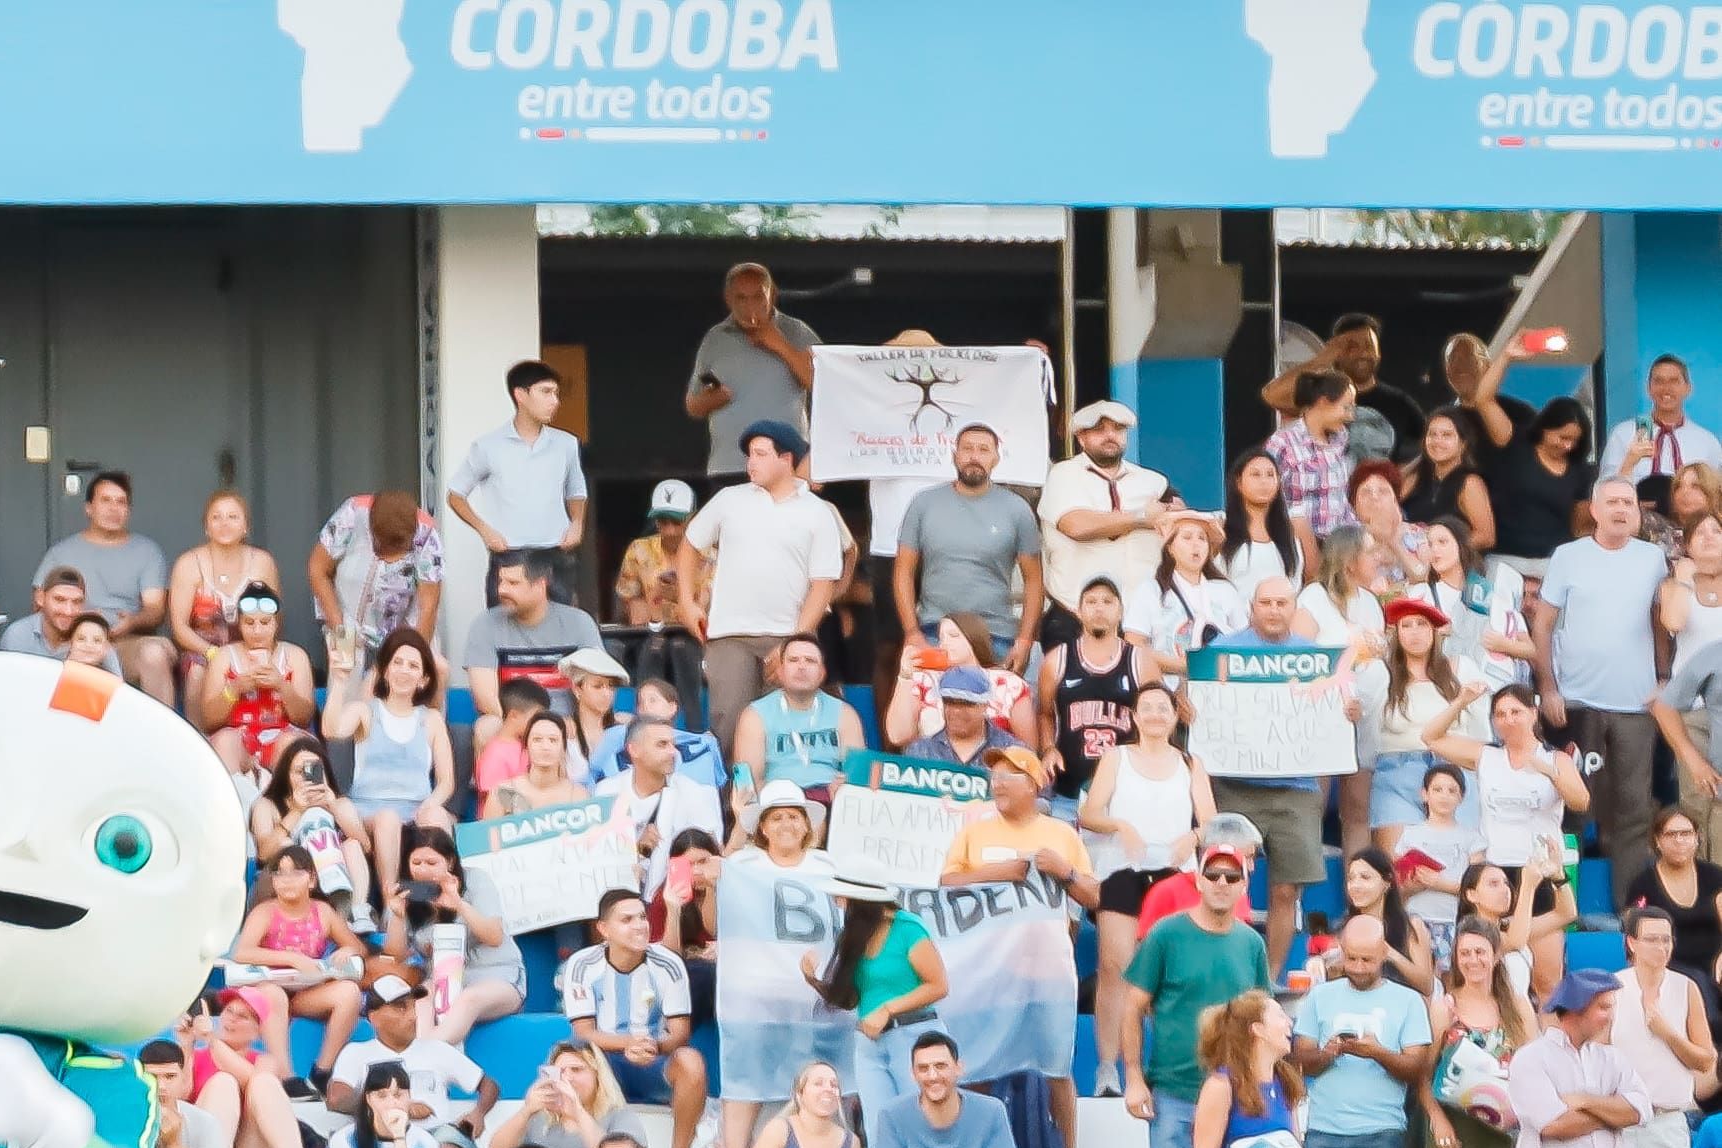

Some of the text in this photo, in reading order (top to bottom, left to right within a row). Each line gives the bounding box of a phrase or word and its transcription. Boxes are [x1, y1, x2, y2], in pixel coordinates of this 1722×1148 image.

[517, 73, 773, 120] entre todos
[1478, 82, 1722, 129] entre todos
[1228, 653, 1331, 679] BANCOR
[1069, 699, 1132, 732] BULLS
[1083, 728, 1117, 758] 23
[881, 762, 990, 800] BANCOR
[499, 803, 603, 843] BANCOR
[861, 834, 945, 874] PRESEN
